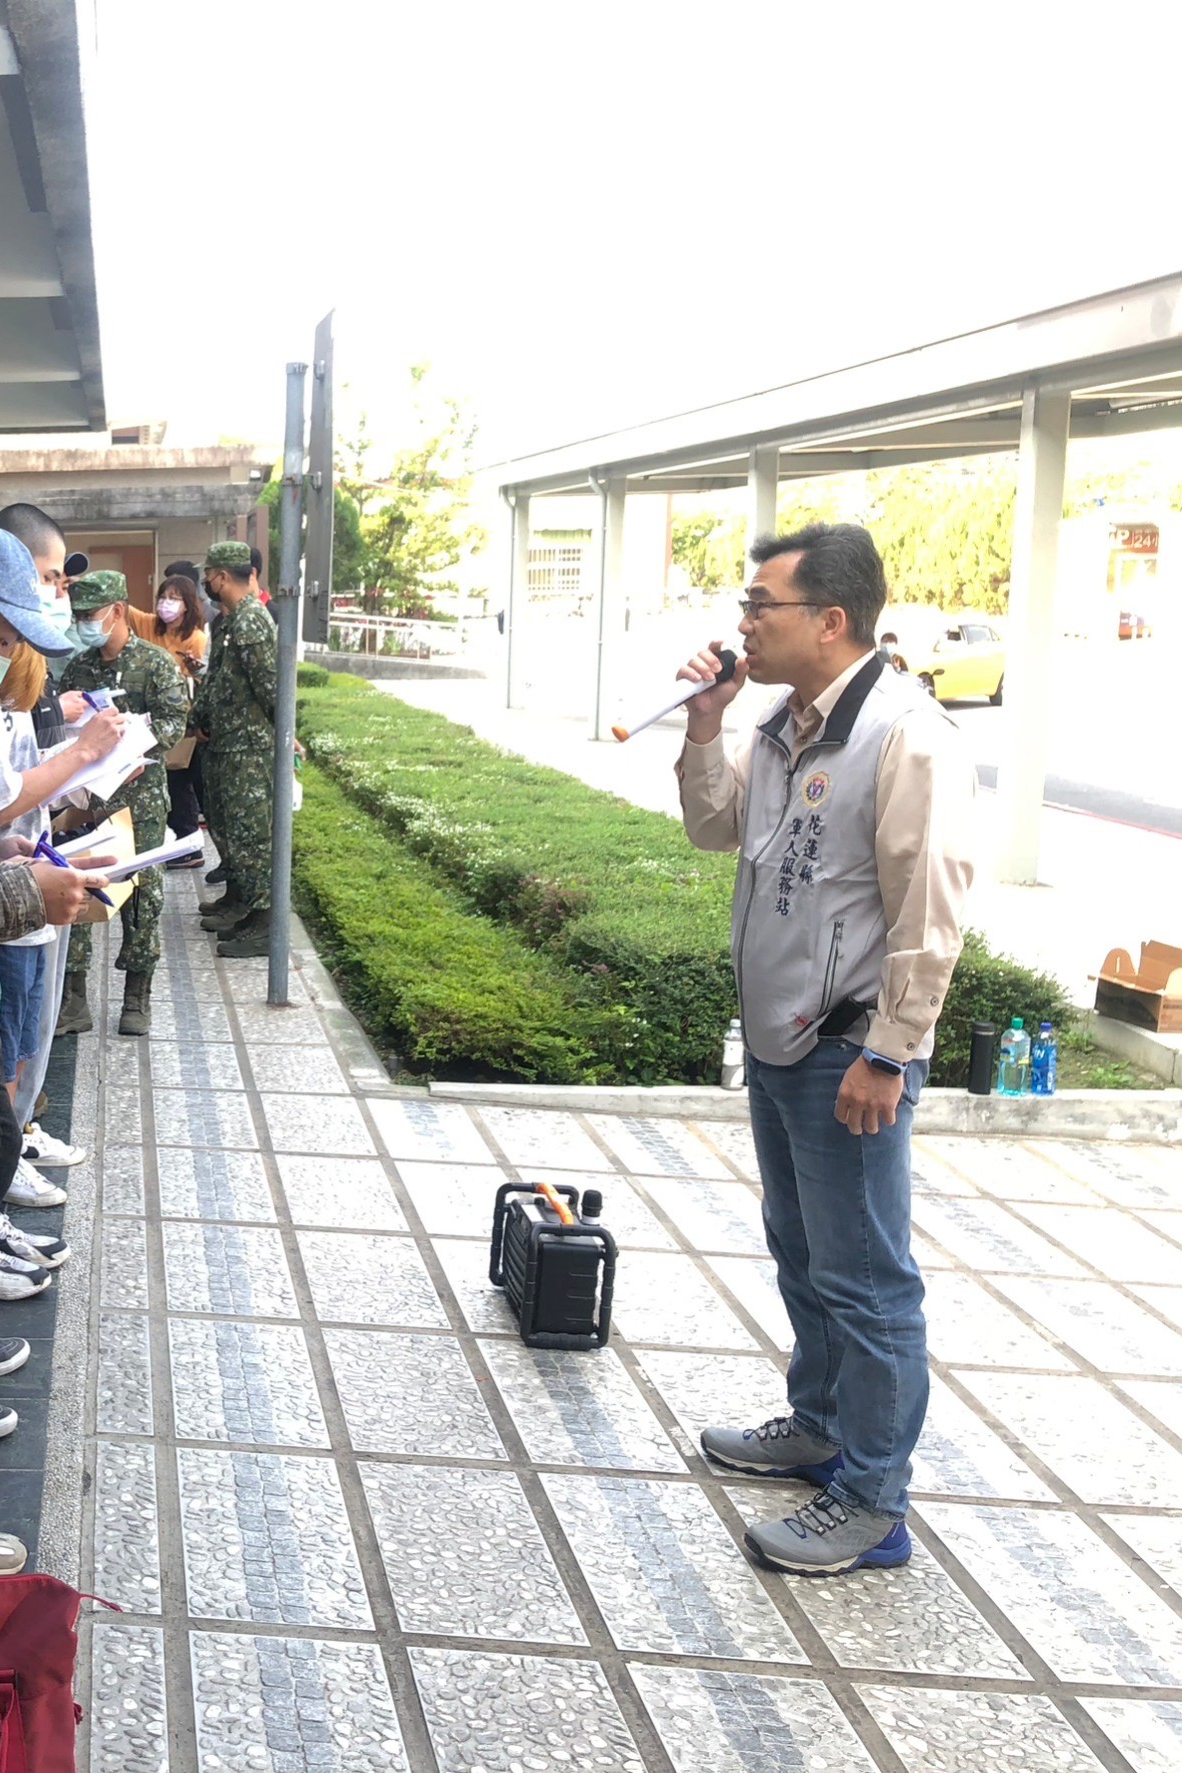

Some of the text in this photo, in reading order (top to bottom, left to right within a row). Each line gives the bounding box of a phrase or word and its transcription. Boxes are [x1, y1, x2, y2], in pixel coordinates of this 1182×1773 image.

[775, 818, 803, 916] 軍人服務站
[799, 814, 823, 885] 花蓮縣
